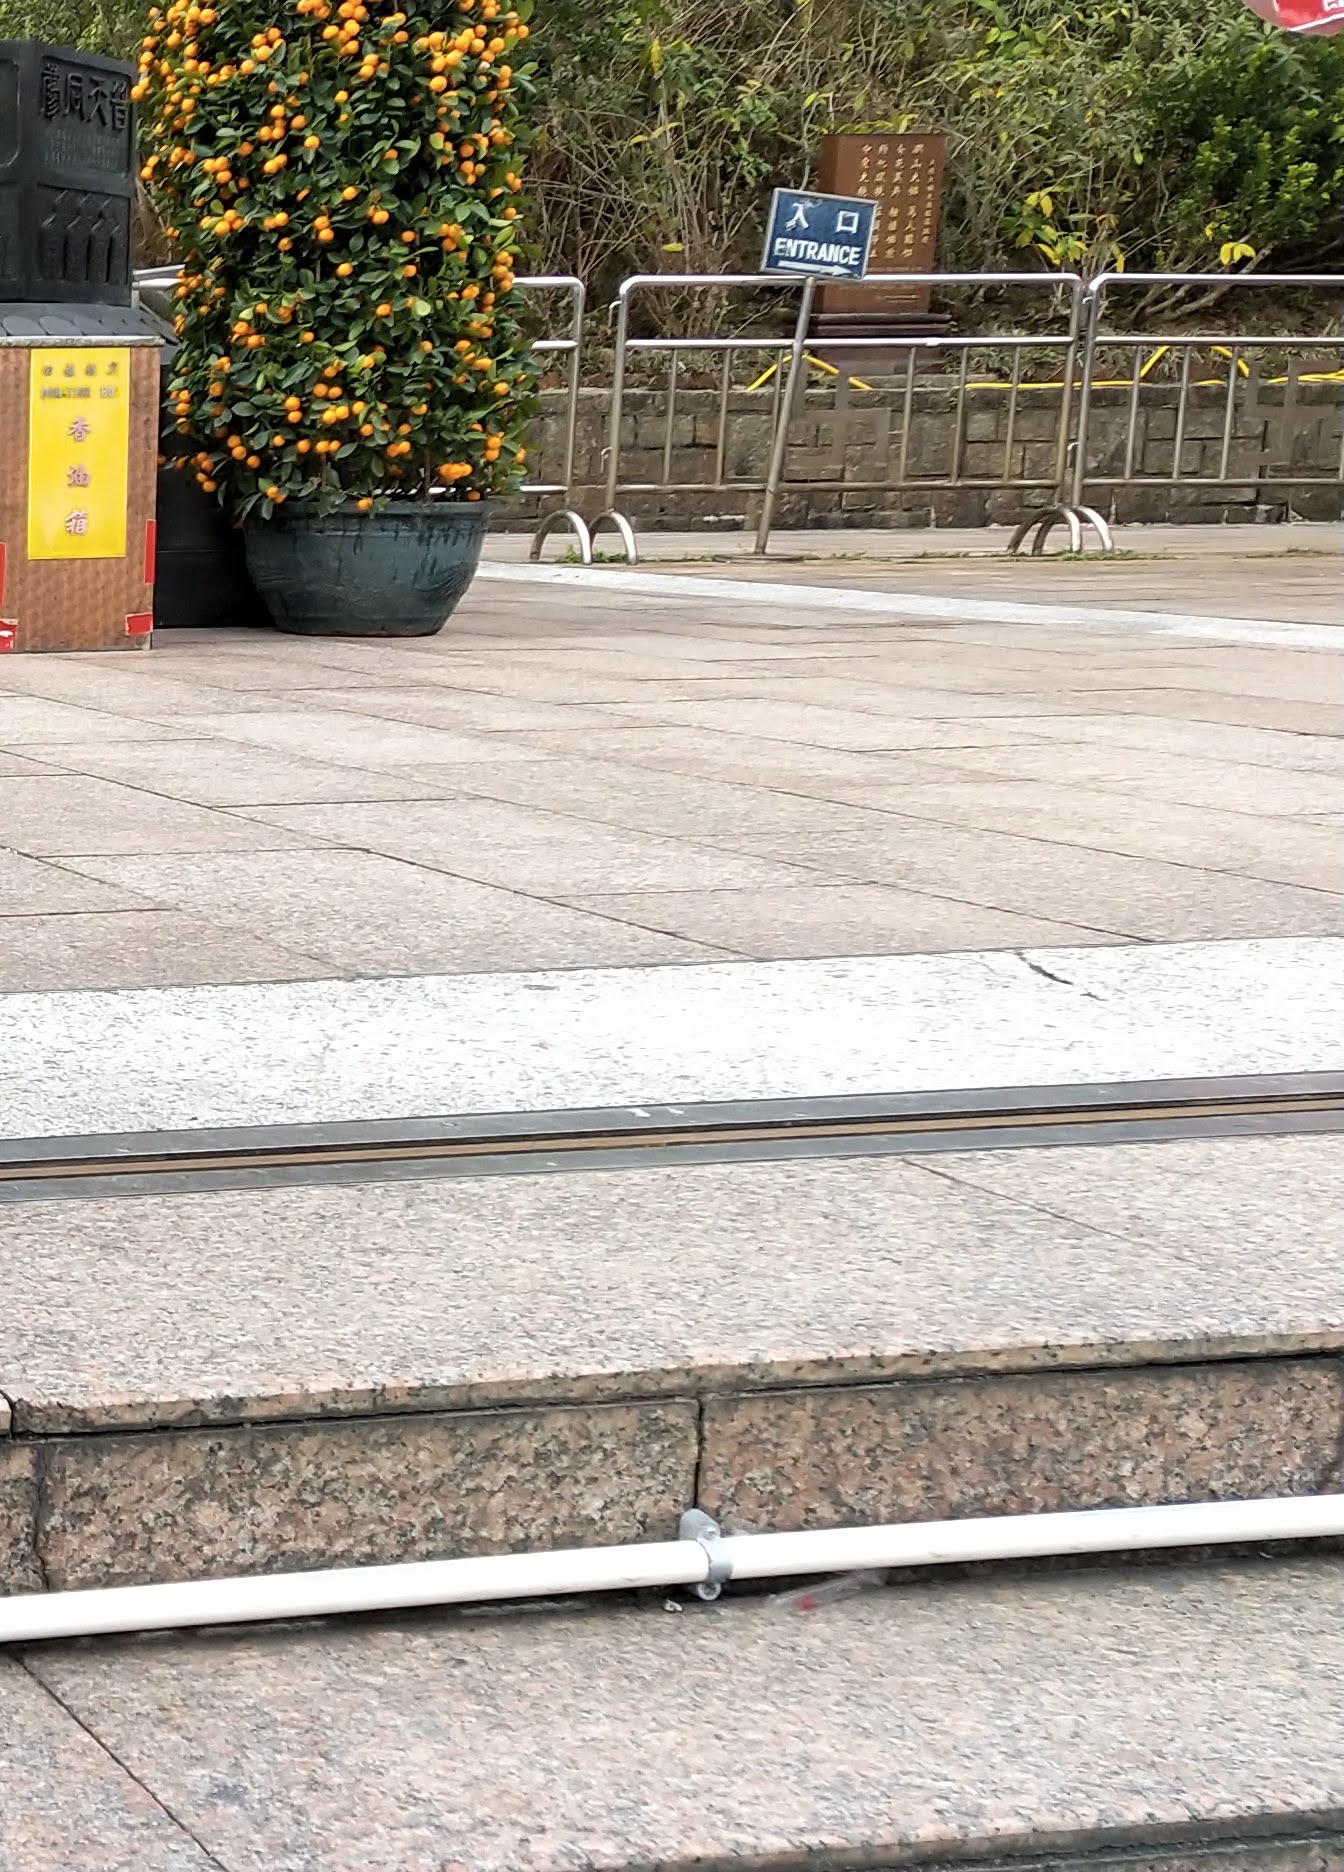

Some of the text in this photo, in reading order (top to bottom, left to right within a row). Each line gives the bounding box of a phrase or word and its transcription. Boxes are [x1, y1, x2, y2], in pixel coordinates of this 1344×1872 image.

[785, 201, 859, 234] 入口
[773, 238, 862, 266] ENTRANCE
[65, 415, 91, 535] 香油箱
